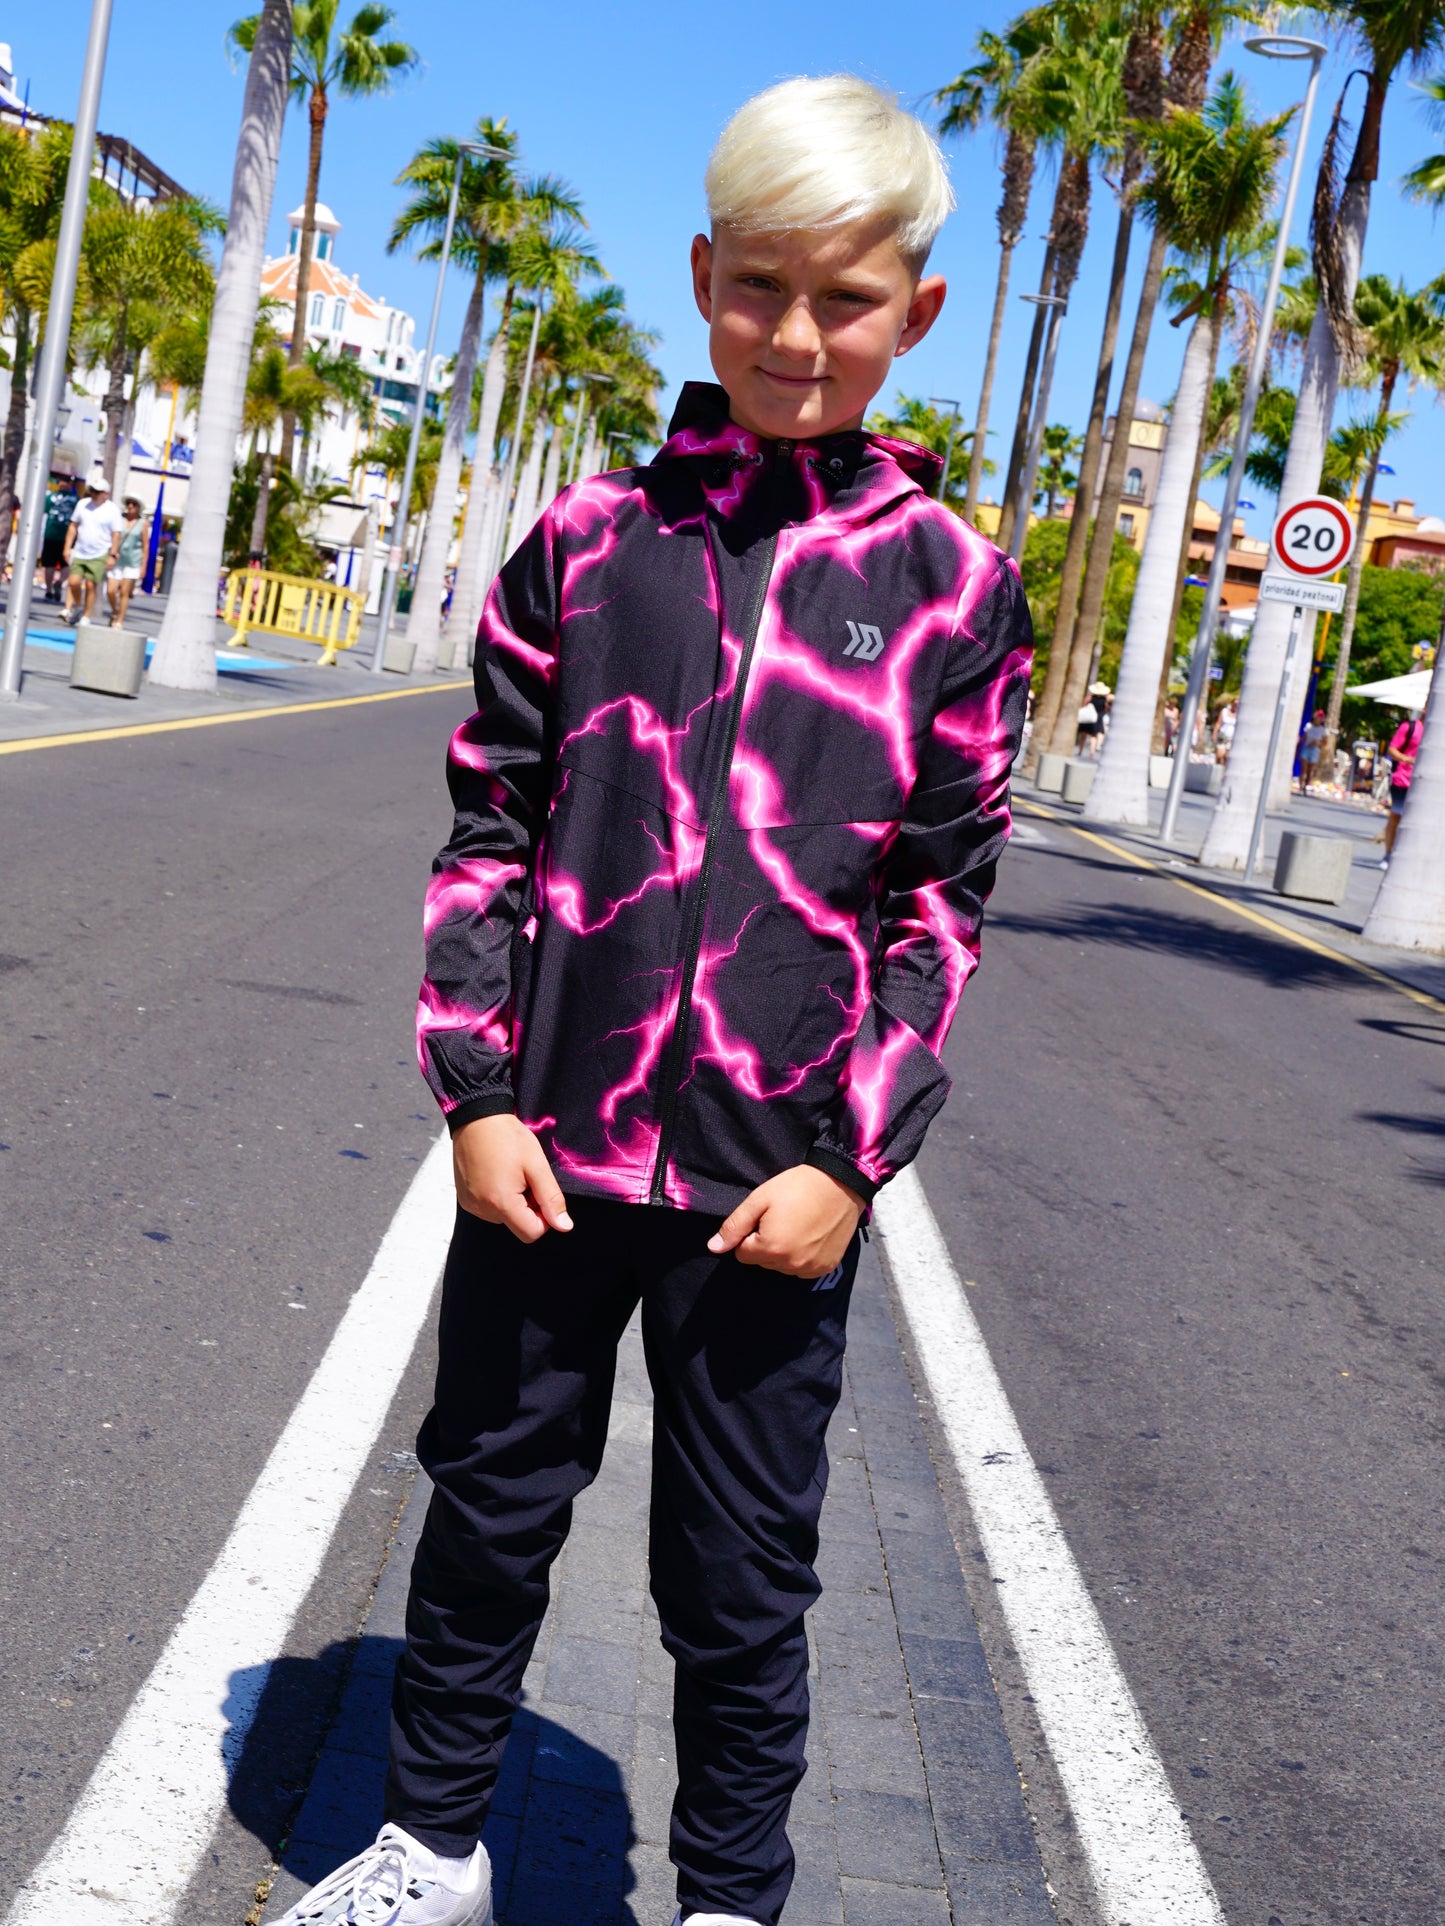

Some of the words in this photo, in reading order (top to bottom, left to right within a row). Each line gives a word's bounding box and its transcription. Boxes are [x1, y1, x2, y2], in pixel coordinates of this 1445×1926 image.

[1291, 524, 1336, 552] 20
[1265, 584, 1300, 597] prioridad
[1302, 590, 1337, 603] peatonal
